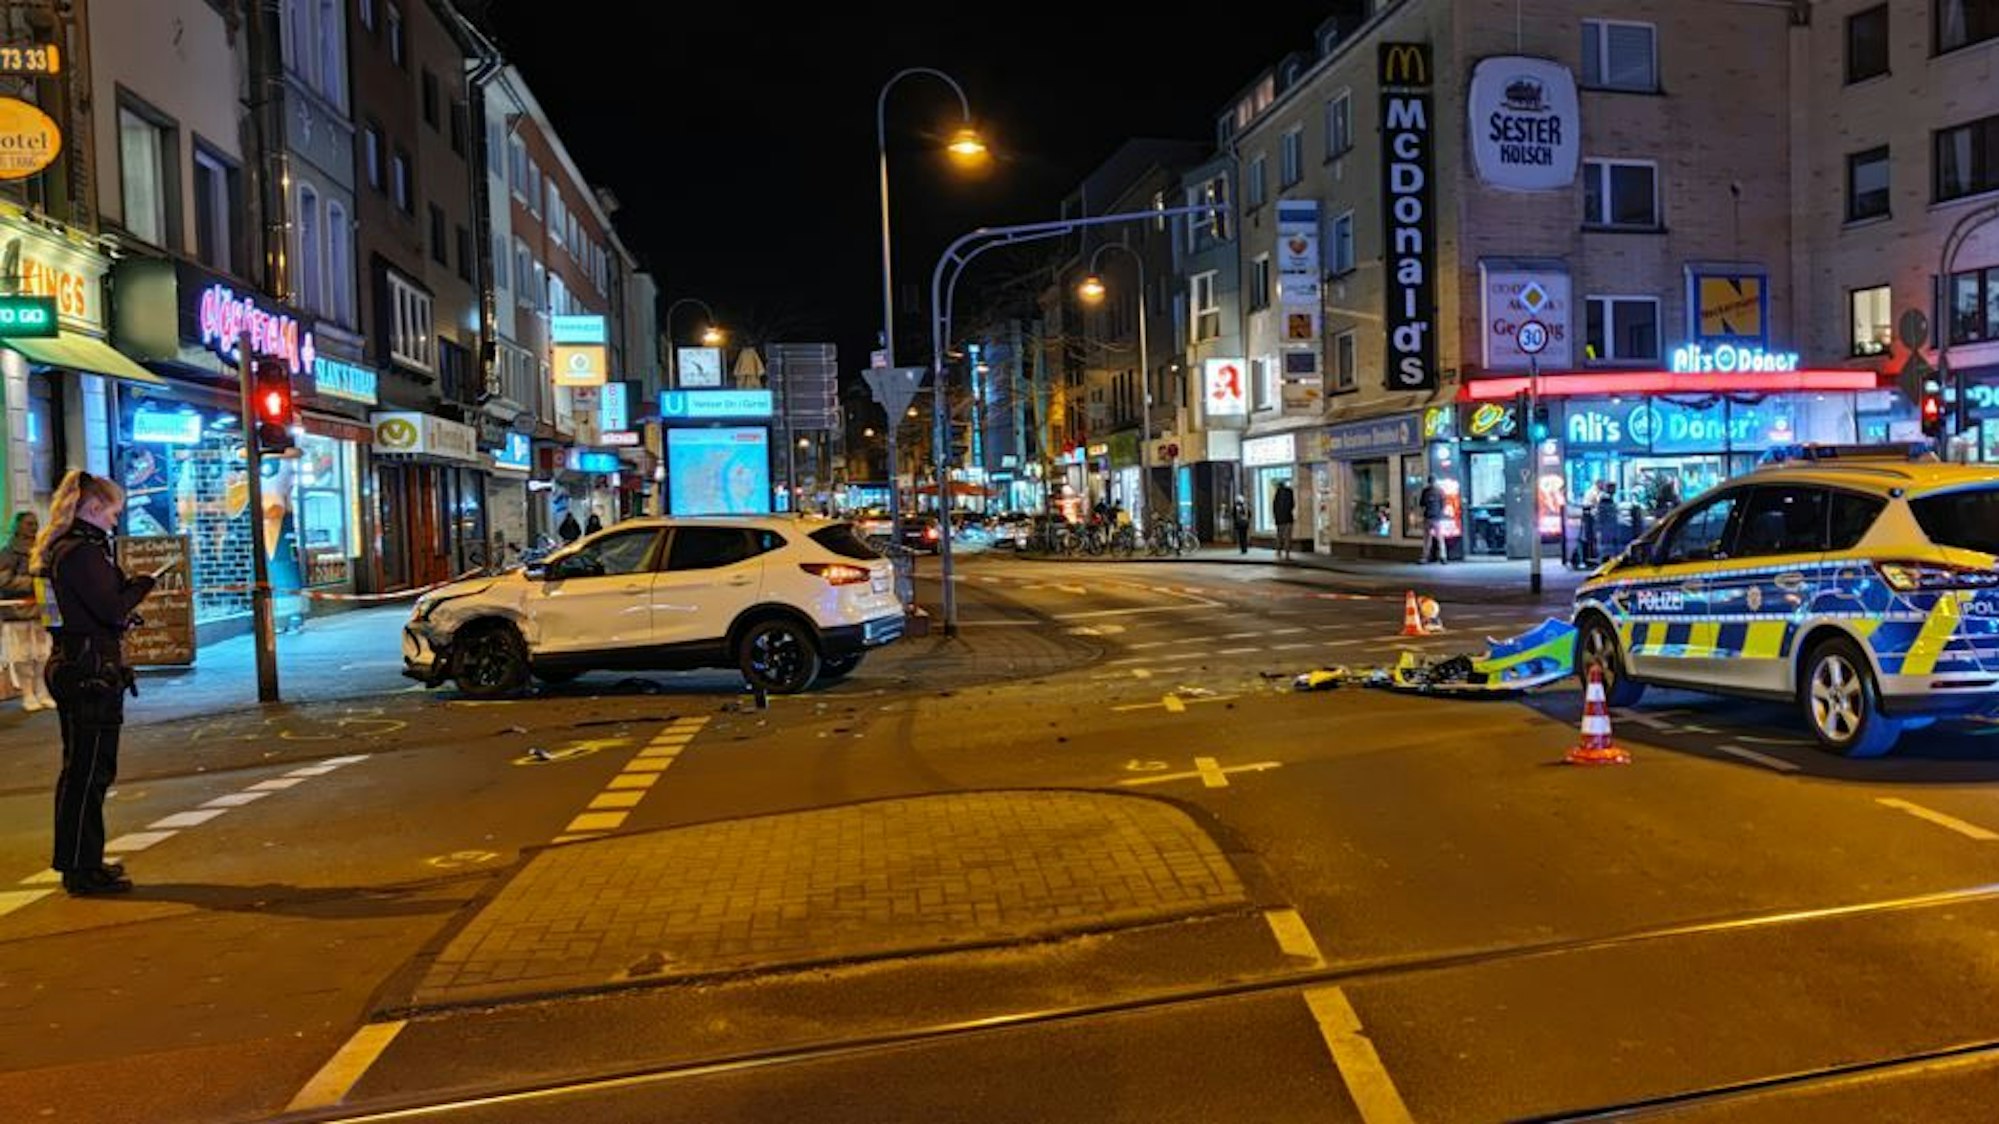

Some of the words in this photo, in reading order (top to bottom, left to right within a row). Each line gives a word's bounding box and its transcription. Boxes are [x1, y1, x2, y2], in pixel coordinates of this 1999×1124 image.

[26, 48, 46, 70] 33
[1489, 112, 1561, 146] SESTER
[1387, 98, 1428, 386] McDonald's
[1522, 329, 1542, 346] 30
[1738, 347, 1799, 372] Döner
[1568, 411, 1621, 443] Ali's
[1637, 590, 1684, 611] POLIZEI
